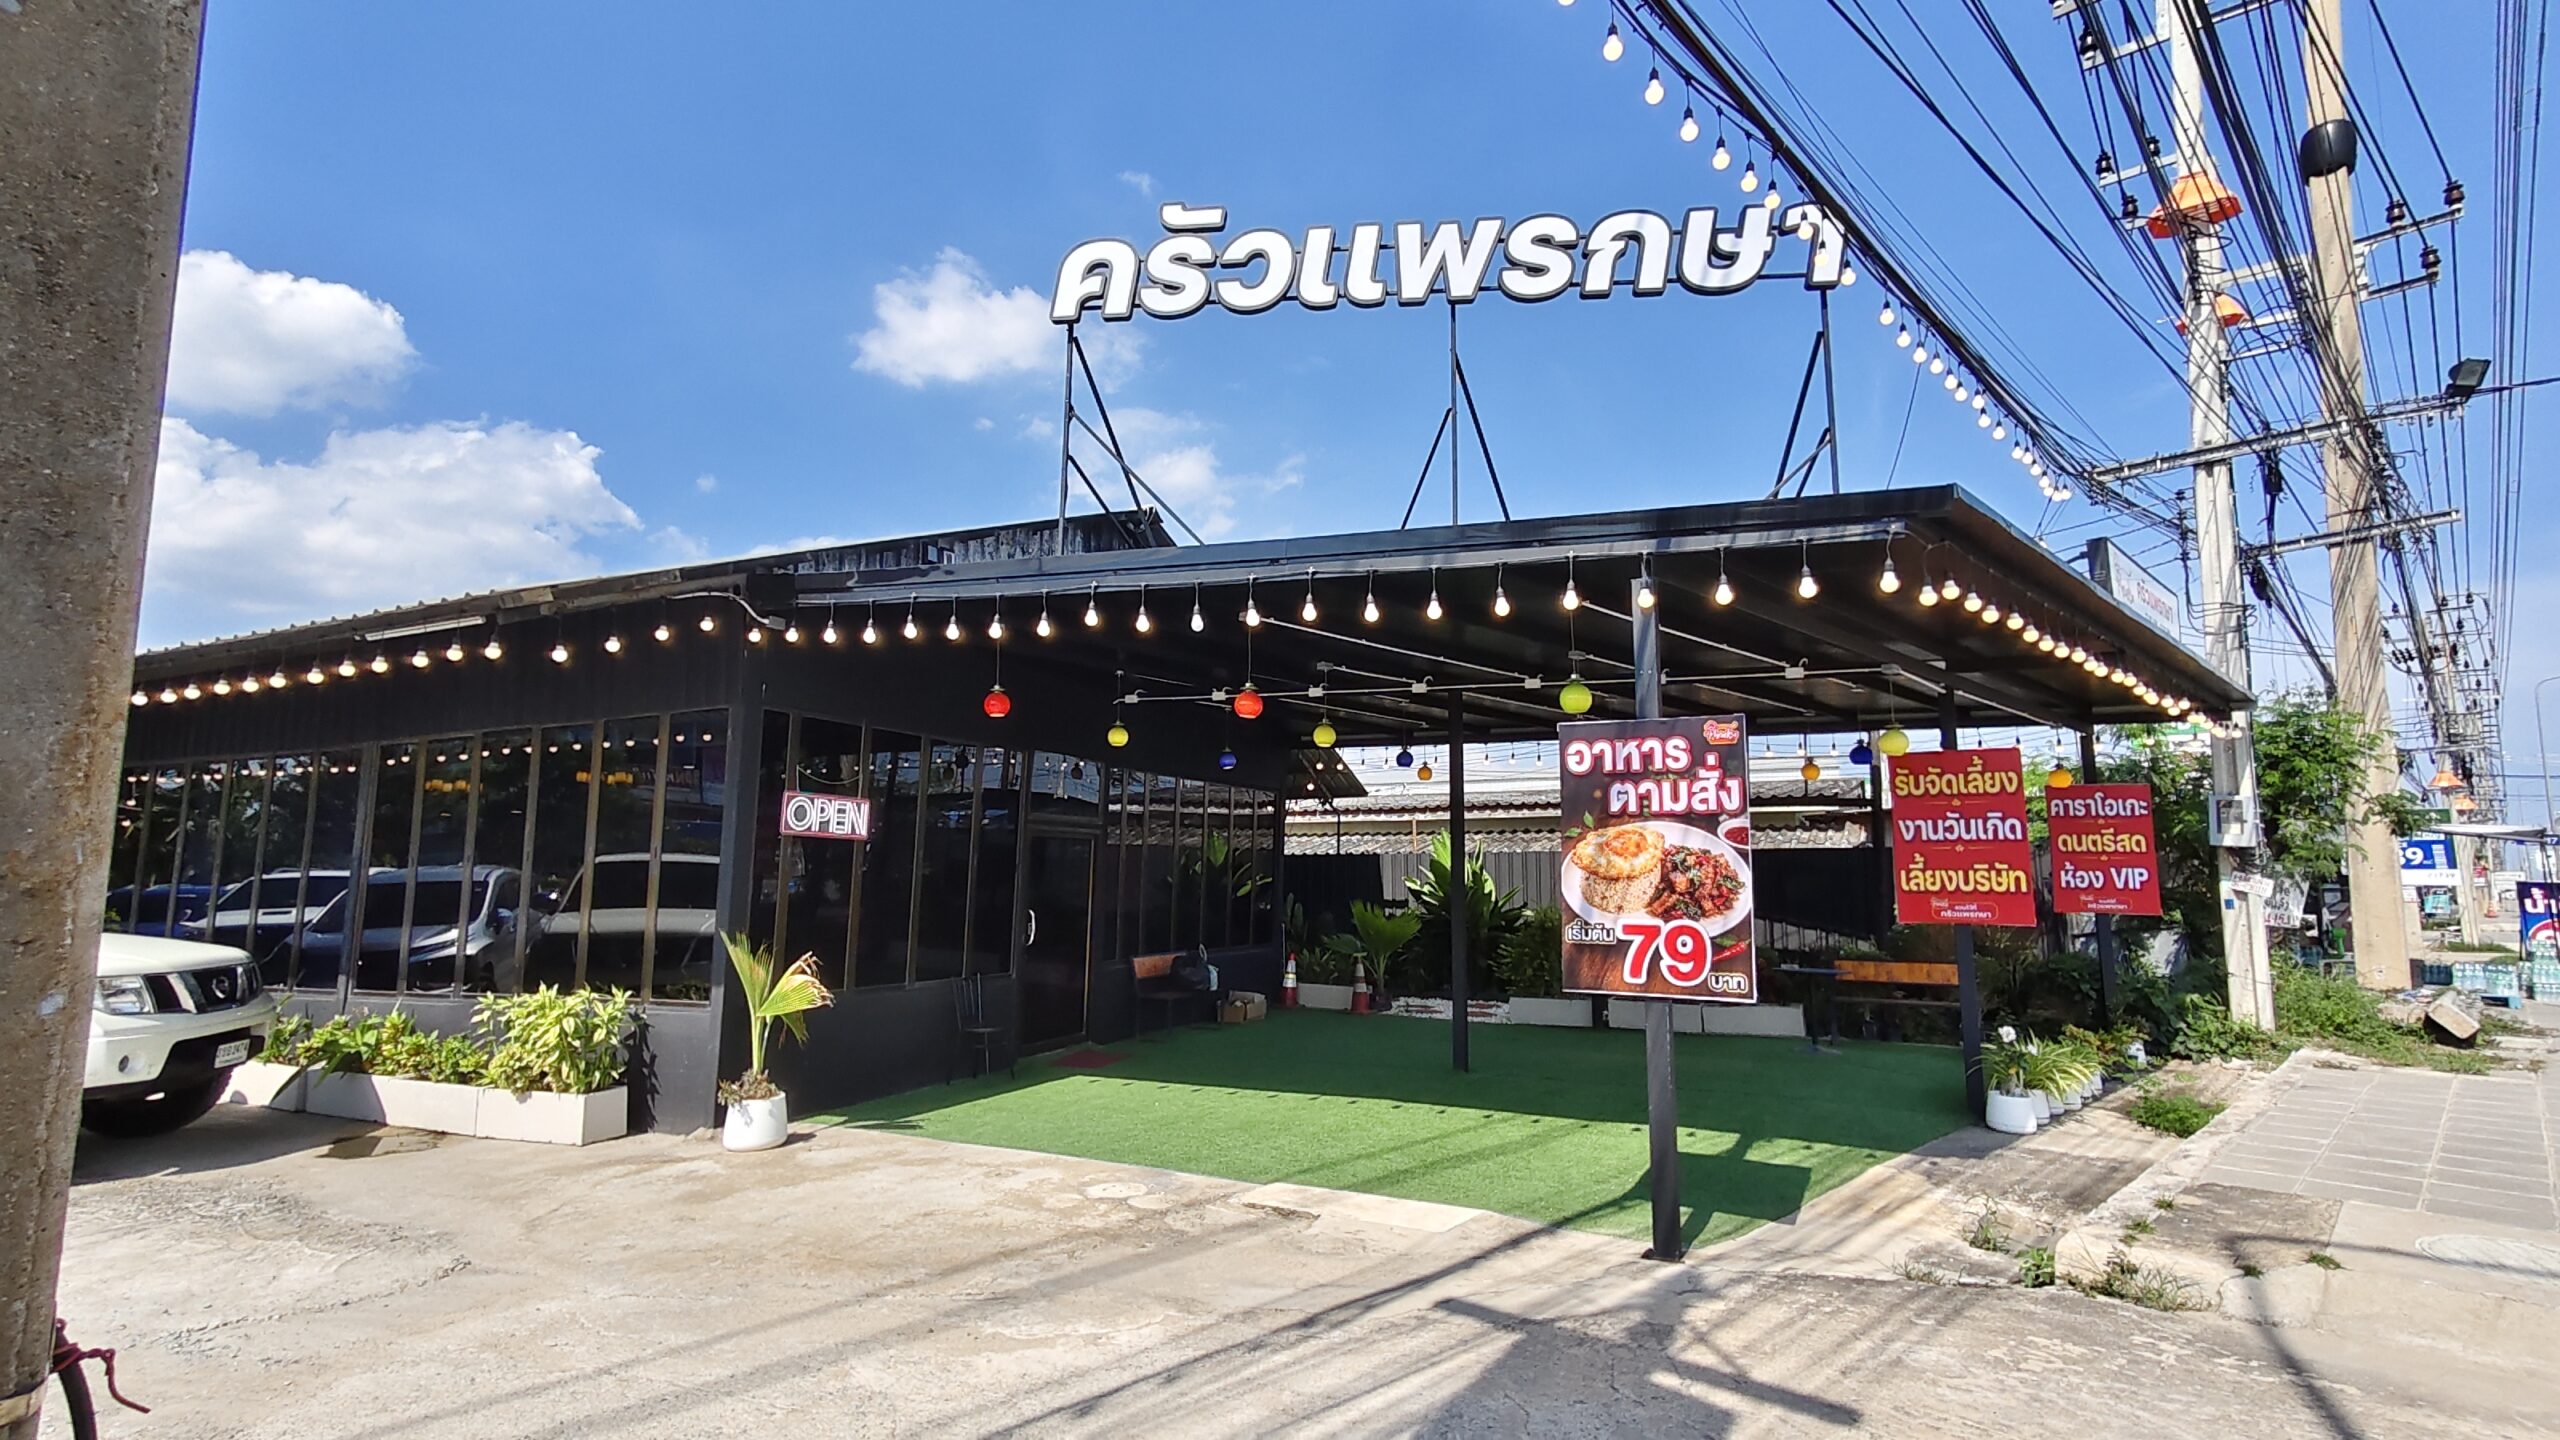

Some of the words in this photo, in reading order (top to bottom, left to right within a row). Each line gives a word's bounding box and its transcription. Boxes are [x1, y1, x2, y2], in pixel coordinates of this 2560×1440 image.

[1050, 201, 1847, 324] ครัวแพรกษา
[1566, 737, 1691, 773] อาหาร
[1609, 753, 1743, 813] ตามสั่ง
[1894, 756, 2018, 797] รับจัดเลี้ยง
[786, 796, 868, 836] OPEN
[2051, 791, 2148, 817] คาราโอเกะ
[1898, 812, 2023, 842] งานวันเกิด
[2057, 829, 2147, 854] ดนตรีสด
[1900, 854, 2028, 893] เลี้ยงบริษัท
[2060, 863, 2104, 889] ห้อง
[2110, 867, 2148, 890] VIP
[1567, 919, 1614, 942] เริ่มต้น
[1619, 921, 1710, 984] 79
[1709, 973, 1747, 991] บาท
